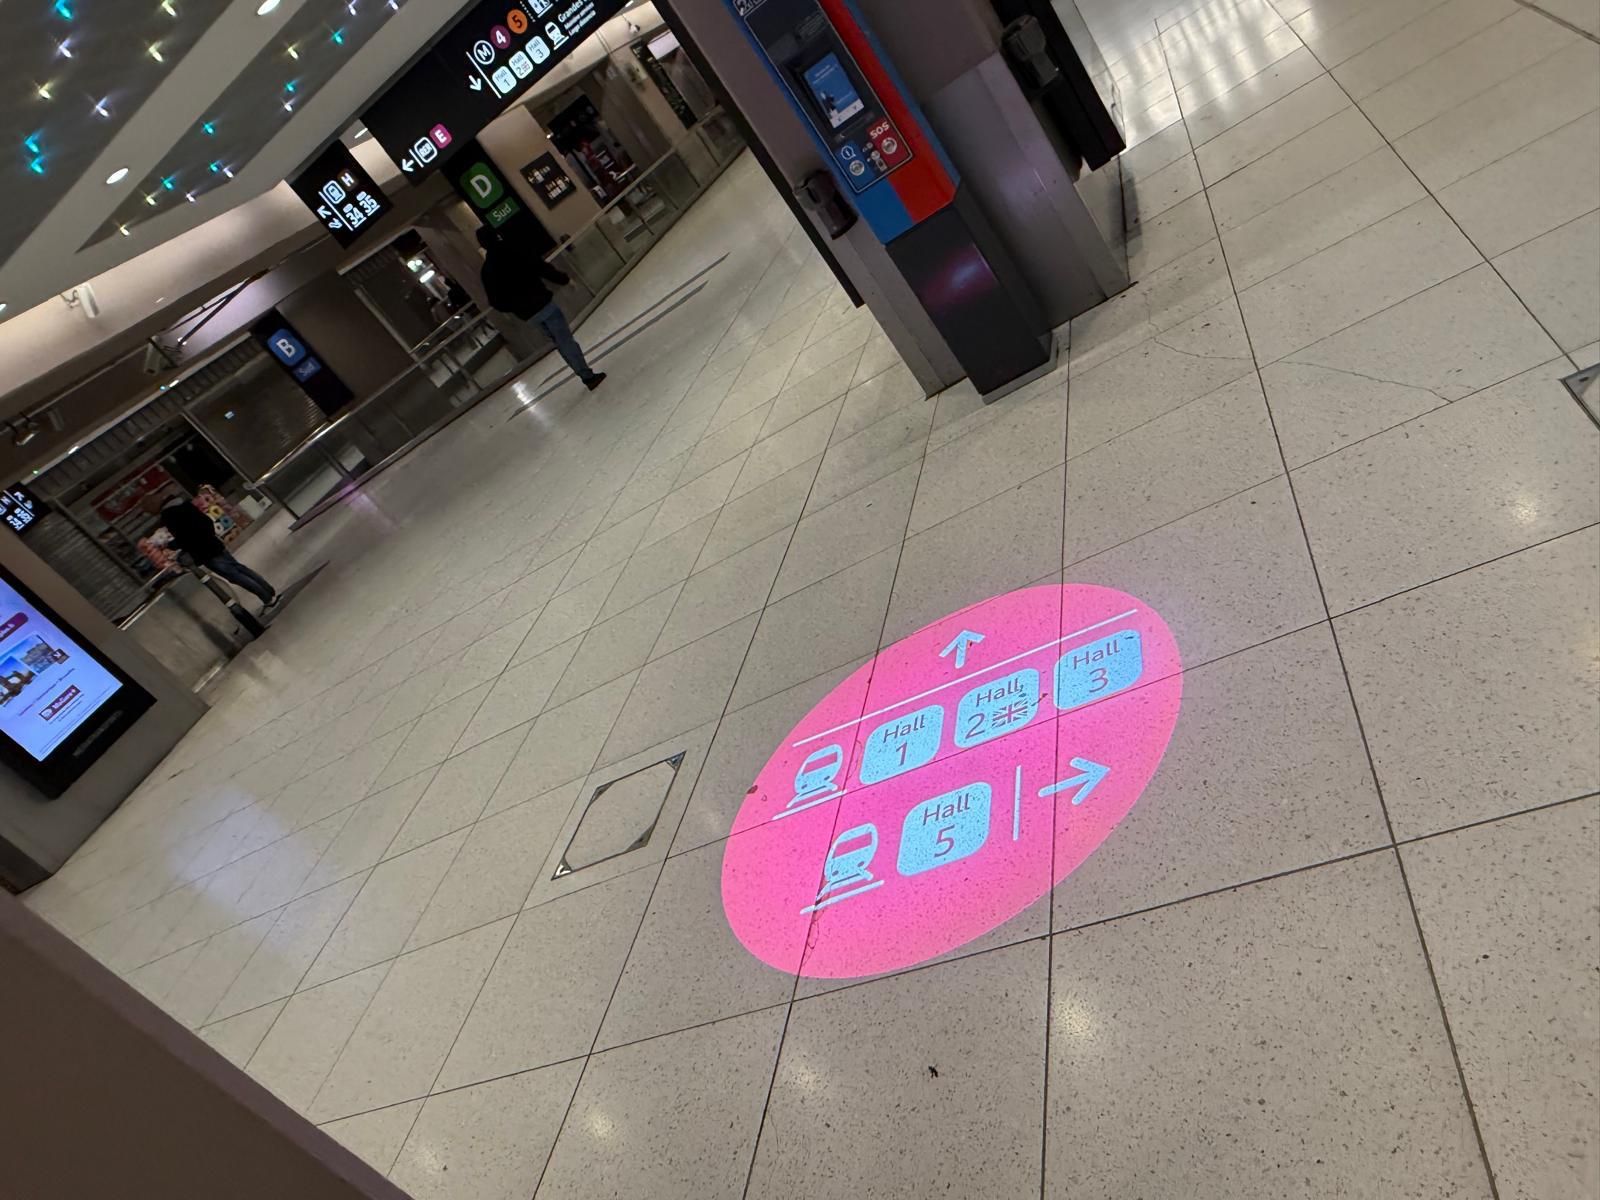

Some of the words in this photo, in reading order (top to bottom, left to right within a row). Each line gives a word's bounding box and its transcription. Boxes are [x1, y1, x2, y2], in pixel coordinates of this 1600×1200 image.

[557, 0, 584, 22] Grandes
[478, 44, 491, 60] M
[495, 30, 507, 44] 4
[511, 15, 523, 29] 5
[528, 39, 541, 51] Hall
[511, 53, 524, 66] Hall
[536, 49, 544, 58] 3
[495, 69, 507, 81] Hall
[516, 66, 524, 76] 2
[434, 129, 447, 144] E
[869, 121, 890, 139] SOS
[341, 173, 354, 187] H
[470, 174, 492, 199] D
[346, 207, 364, 225] 34
[359, 195, 378, 213] 35
[492, 203, 513, 222] Sud
[275, 338, 295, 358] B
[1073, 639, 1120, 670] Hall
[1088, 667, 1109, 693] 3
[975, 677, 1020, 707] Hall
[883, 714, 926, 743] Hall
[965, 712, 986, 739] 2
[895, 742, 908, 767] 1
[922, 793, 970, 826] Hall
[934, 824, 956, 858] 5
